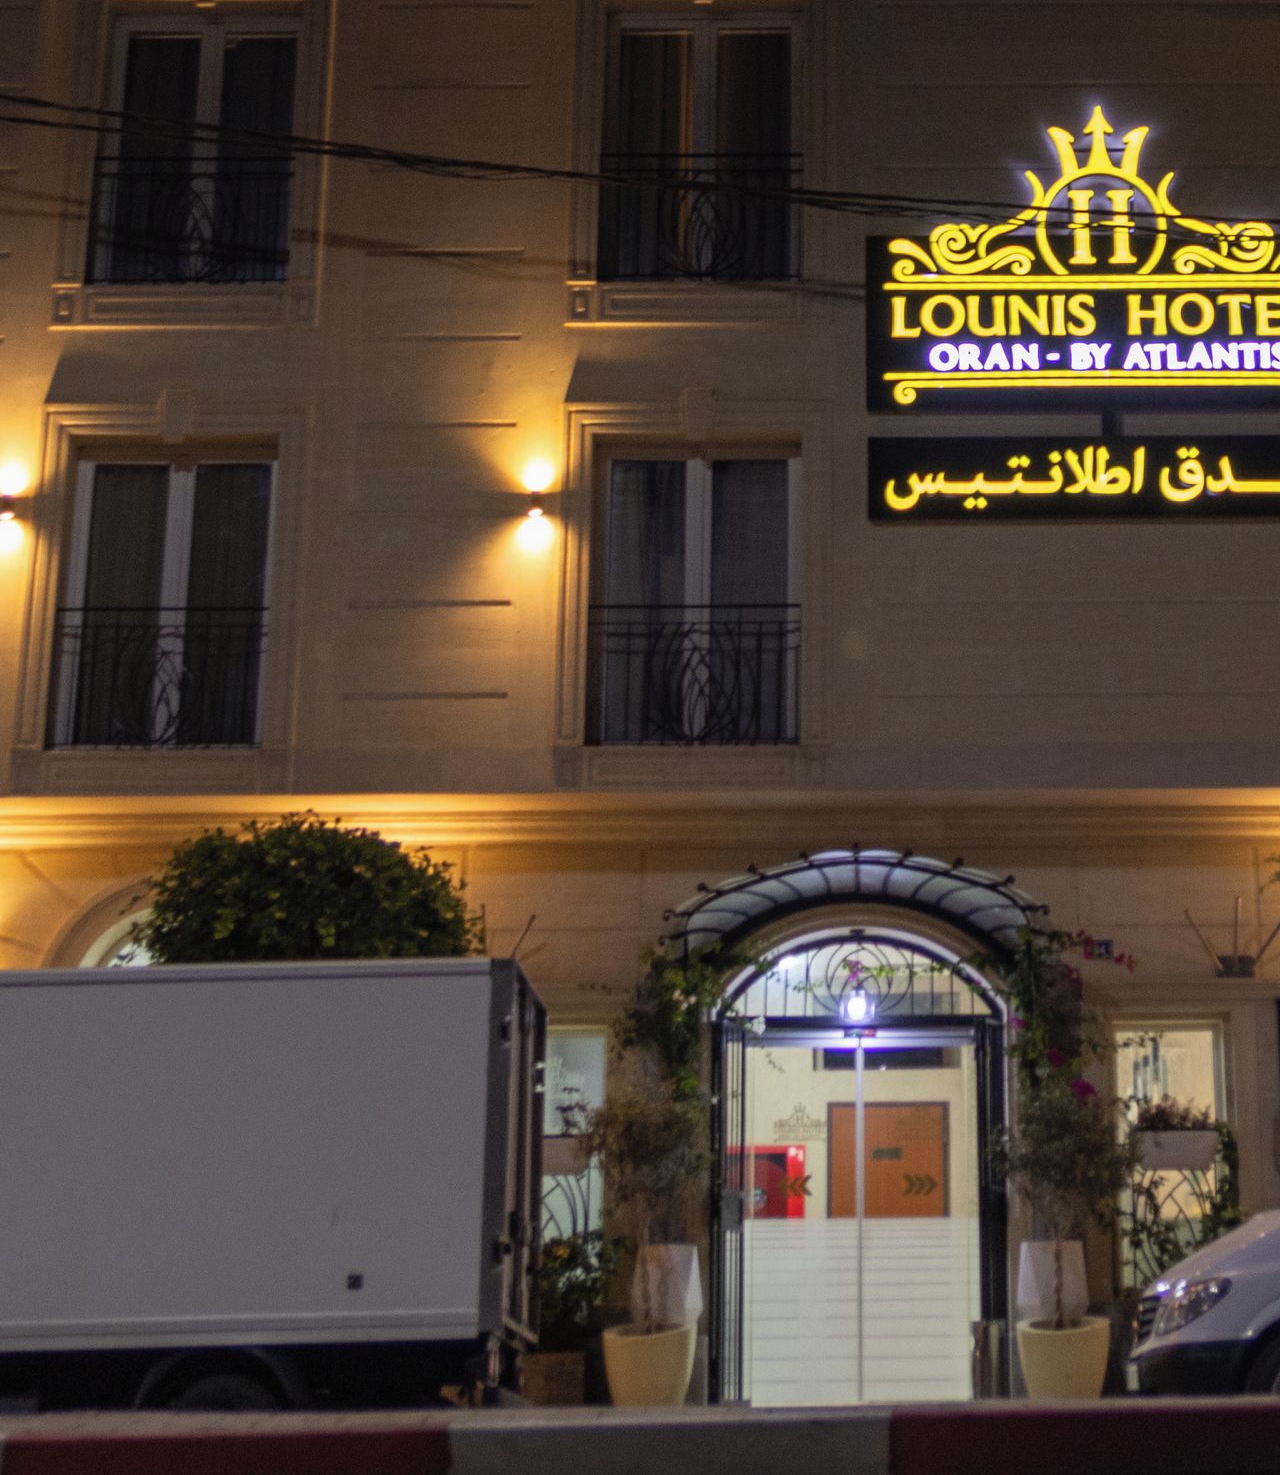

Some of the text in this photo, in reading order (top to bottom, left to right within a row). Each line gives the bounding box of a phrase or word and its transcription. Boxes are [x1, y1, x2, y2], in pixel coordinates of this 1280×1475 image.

[889, 294, 1098, 339] LOUNIS
[928, 341, 1041, 373] ORAN
[1068, 341, 1114, 372] BY
